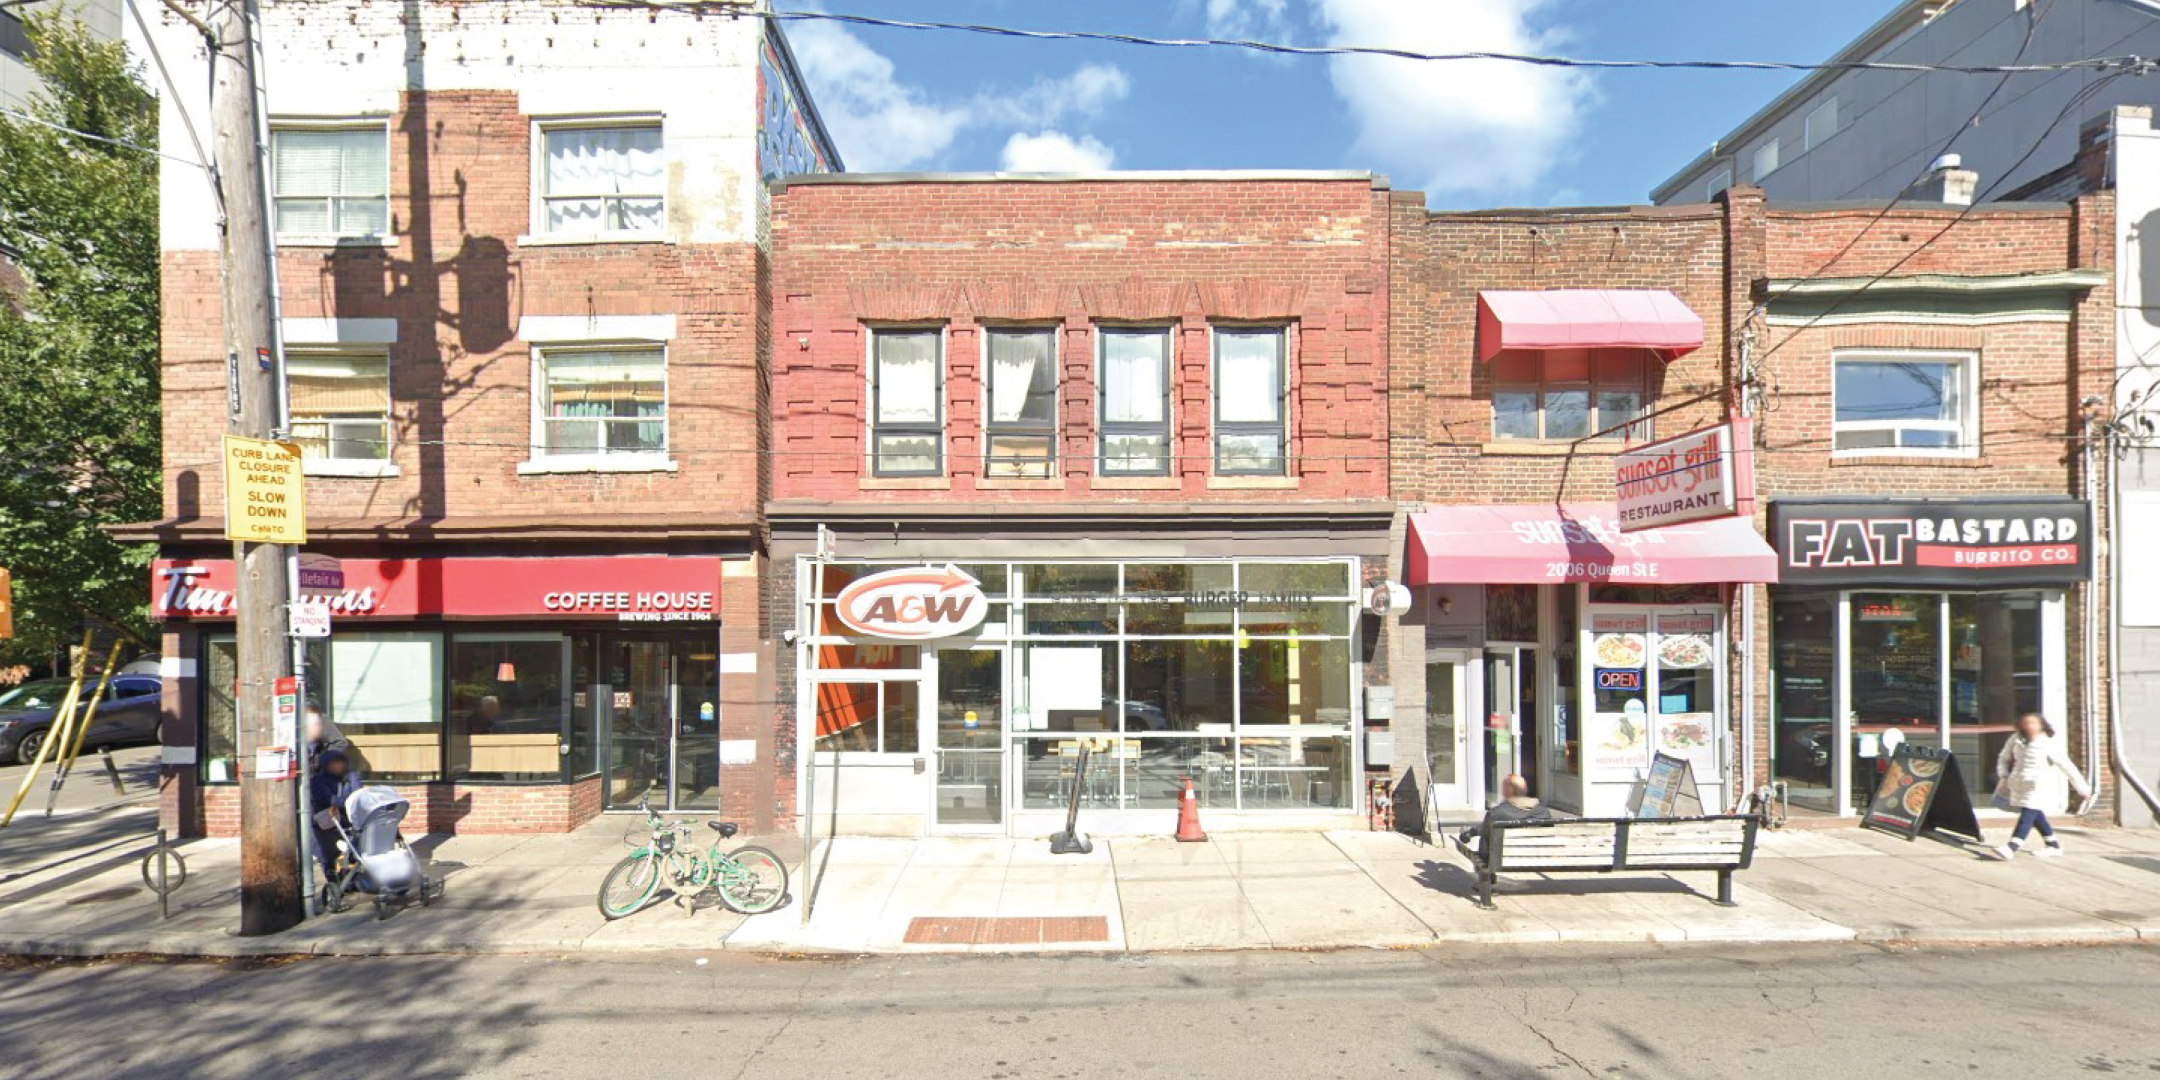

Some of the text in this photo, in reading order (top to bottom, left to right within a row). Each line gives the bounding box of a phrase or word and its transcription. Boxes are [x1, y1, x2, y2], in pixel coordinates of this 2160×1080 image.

[232, 448, 295, 462] CURB LANE
[239, 461, 291, 474] CLOSURE
[1617, 431, 1720, 500] sunset grill
[247, 474, 285, 485] AHEAD
[248, 490, 285, 504] SLOW
[247, 505, 287, 519] DOWN
[1620, 491, 1720, 522] RESTAURANT
[1512, 515, 1615, 544] sunset
[1916, 518, 2078, 543] BASTARD
[1789, 519, 1913, 567] FAT
[1954, 548, 2076, 565] BURRITO CO.
[1546, 562, 1659, 578] 2006 Queen St E
[299, 572, 329, 586] ellefair
[157, 566, 227, 612] Tim
[544, 591, 712, 609] COFFEE HOUSE
[1184, 591, 1248, 607] BURGER
[294, 607, 327, 625] NO STANDING
[619, 612, 711, 621] BREWING SINCE 1964
[860, 594, 975, 624] A&W
[1600, 673, 1639, 687] OPEN
